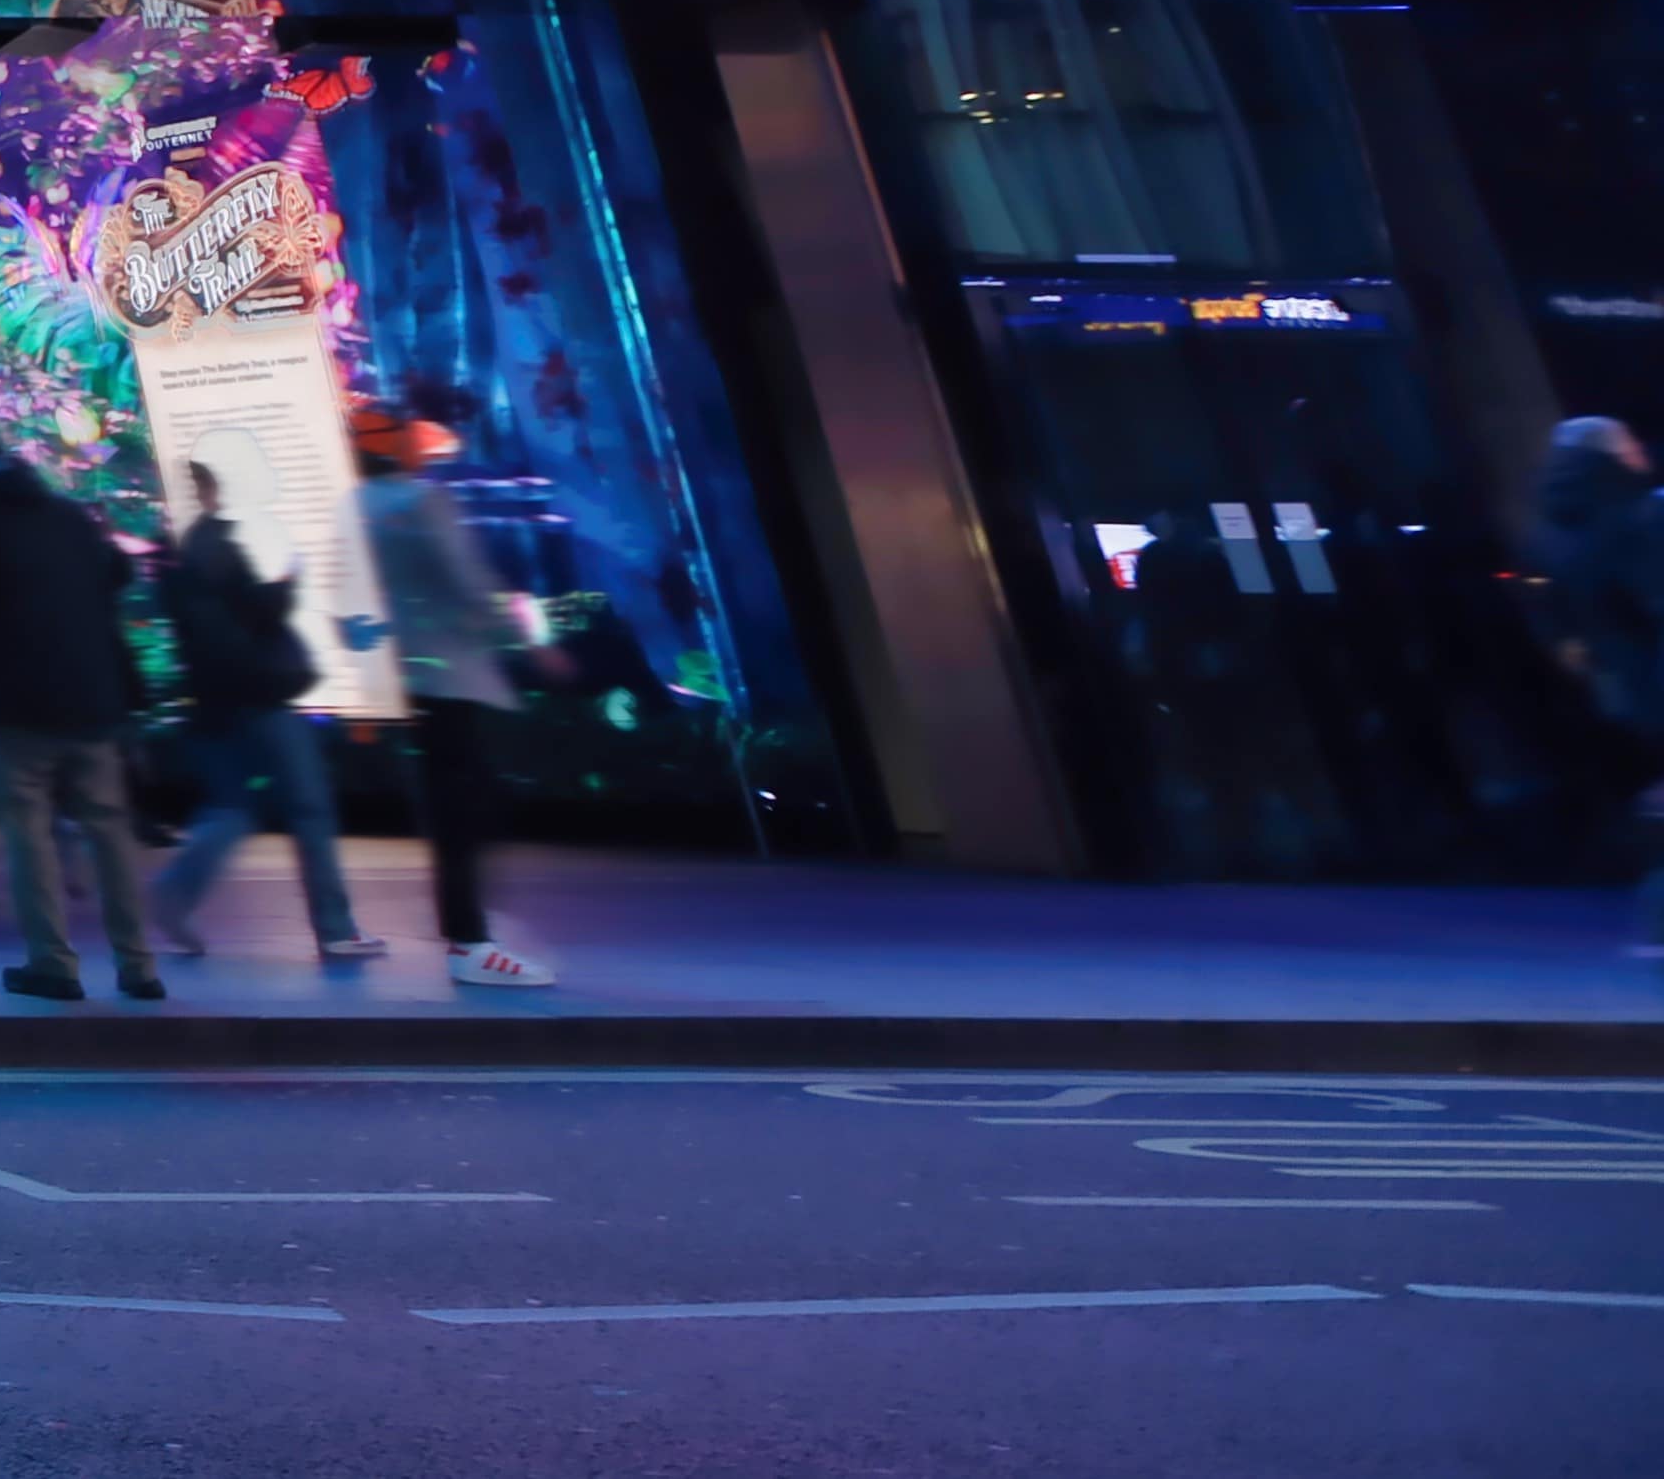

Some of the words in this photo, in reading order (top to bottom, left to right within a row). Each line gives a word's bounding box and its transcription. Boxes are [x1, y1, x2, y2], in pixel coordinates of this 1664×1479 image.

[147, 128, 214, 151] OUTERNET
[125, 177, 281, 312] BUTTERFLY
[188, 242, 264, 317] TRAIL
